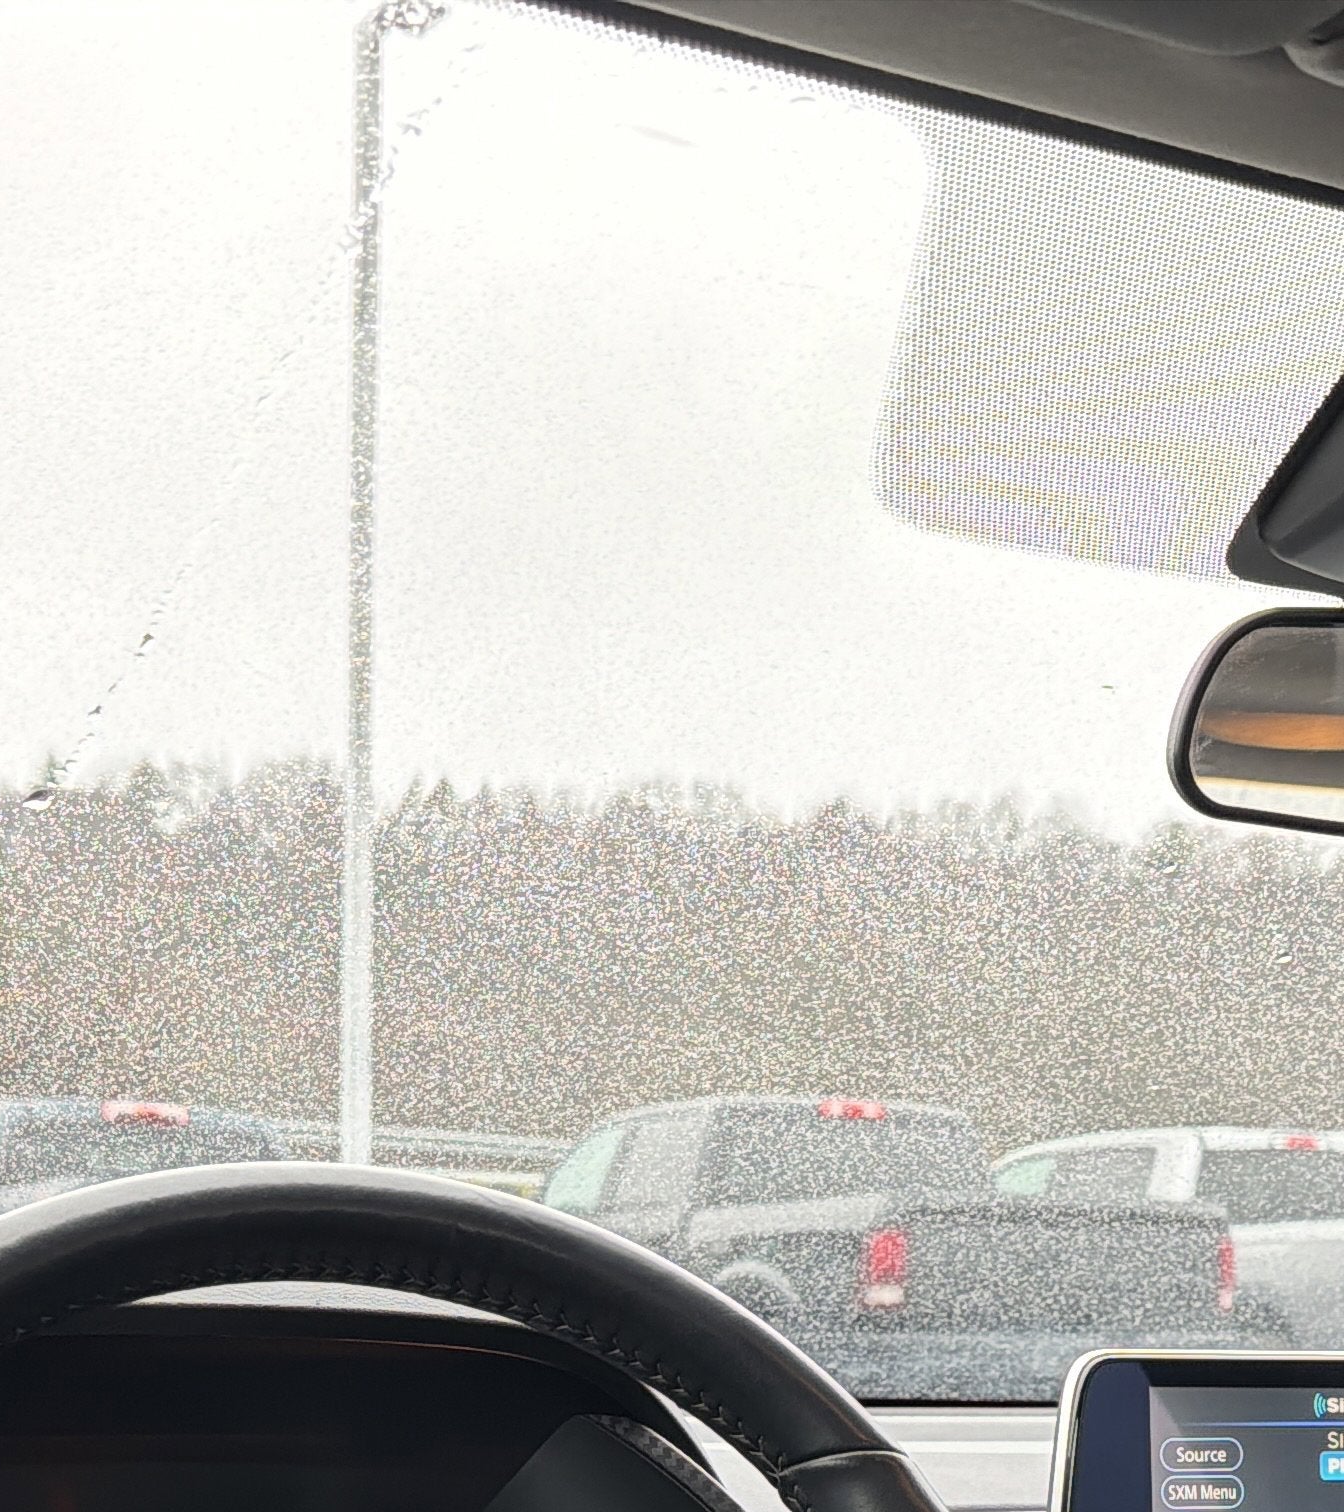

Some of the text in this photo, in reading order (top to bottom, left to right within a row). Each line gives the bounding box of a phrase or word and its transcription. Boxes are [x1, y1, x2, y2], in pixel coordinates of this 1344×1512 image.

[1175, 1447, 1227, 1463] Source
[1168, 1484, 1237, 1501] SXM Menu
